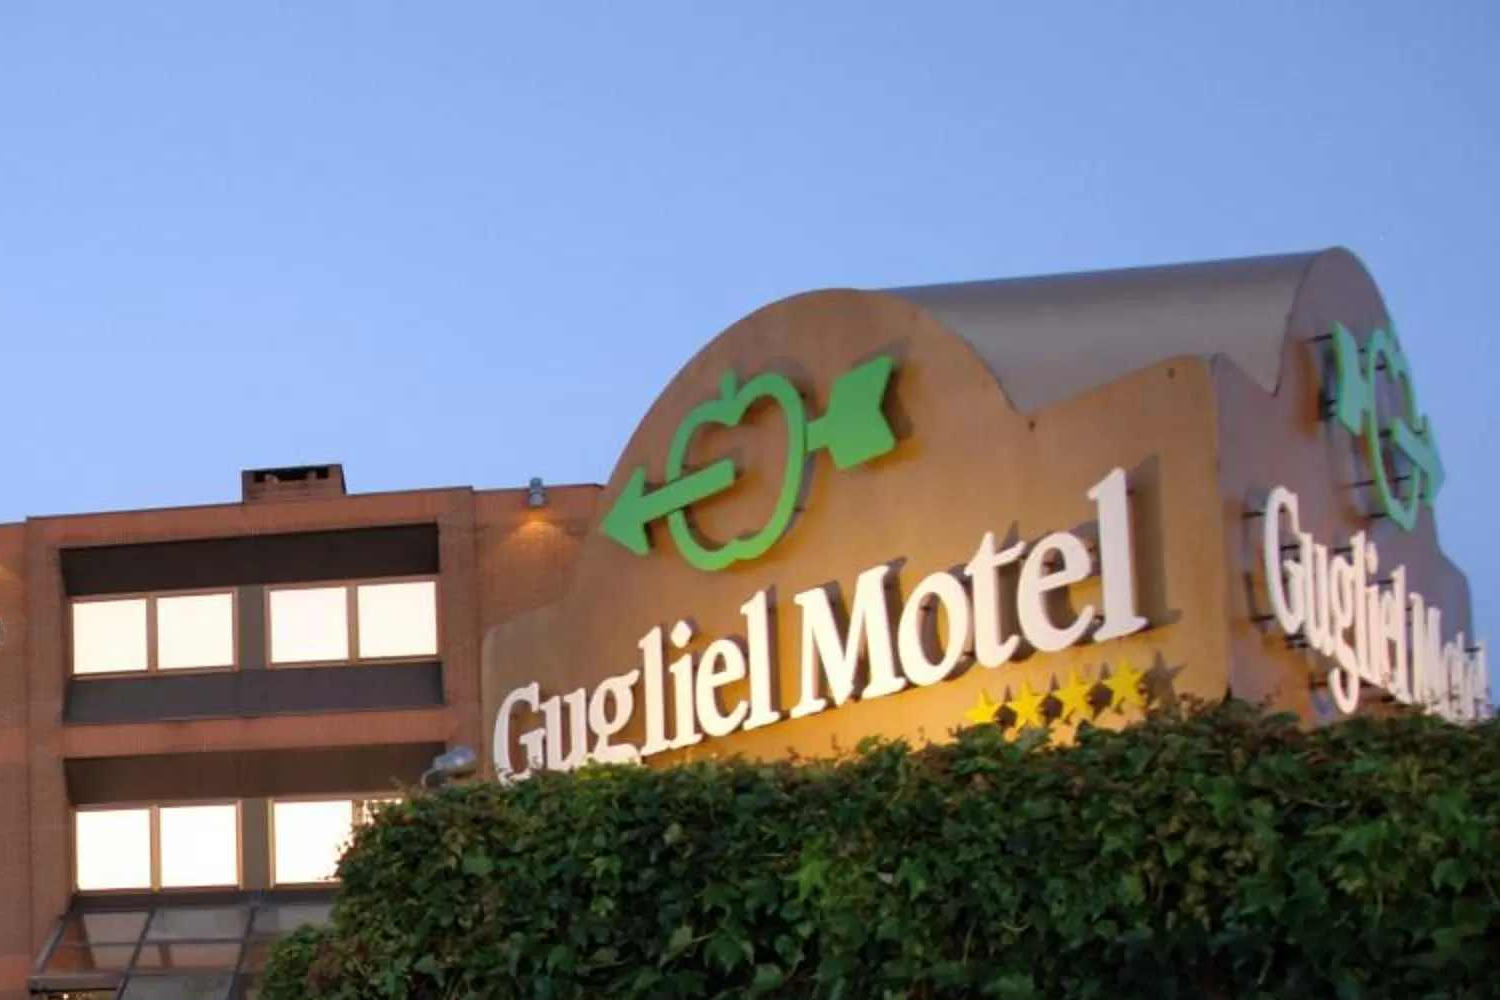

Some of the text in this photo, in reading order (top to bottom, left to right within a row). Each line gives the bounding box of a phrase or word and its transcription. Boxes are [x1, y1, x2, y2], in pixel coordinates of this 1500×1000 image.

[493, 466, 1150, 788] Gugliel Motel
[1263, 485, 1412, 715] Gugliel
